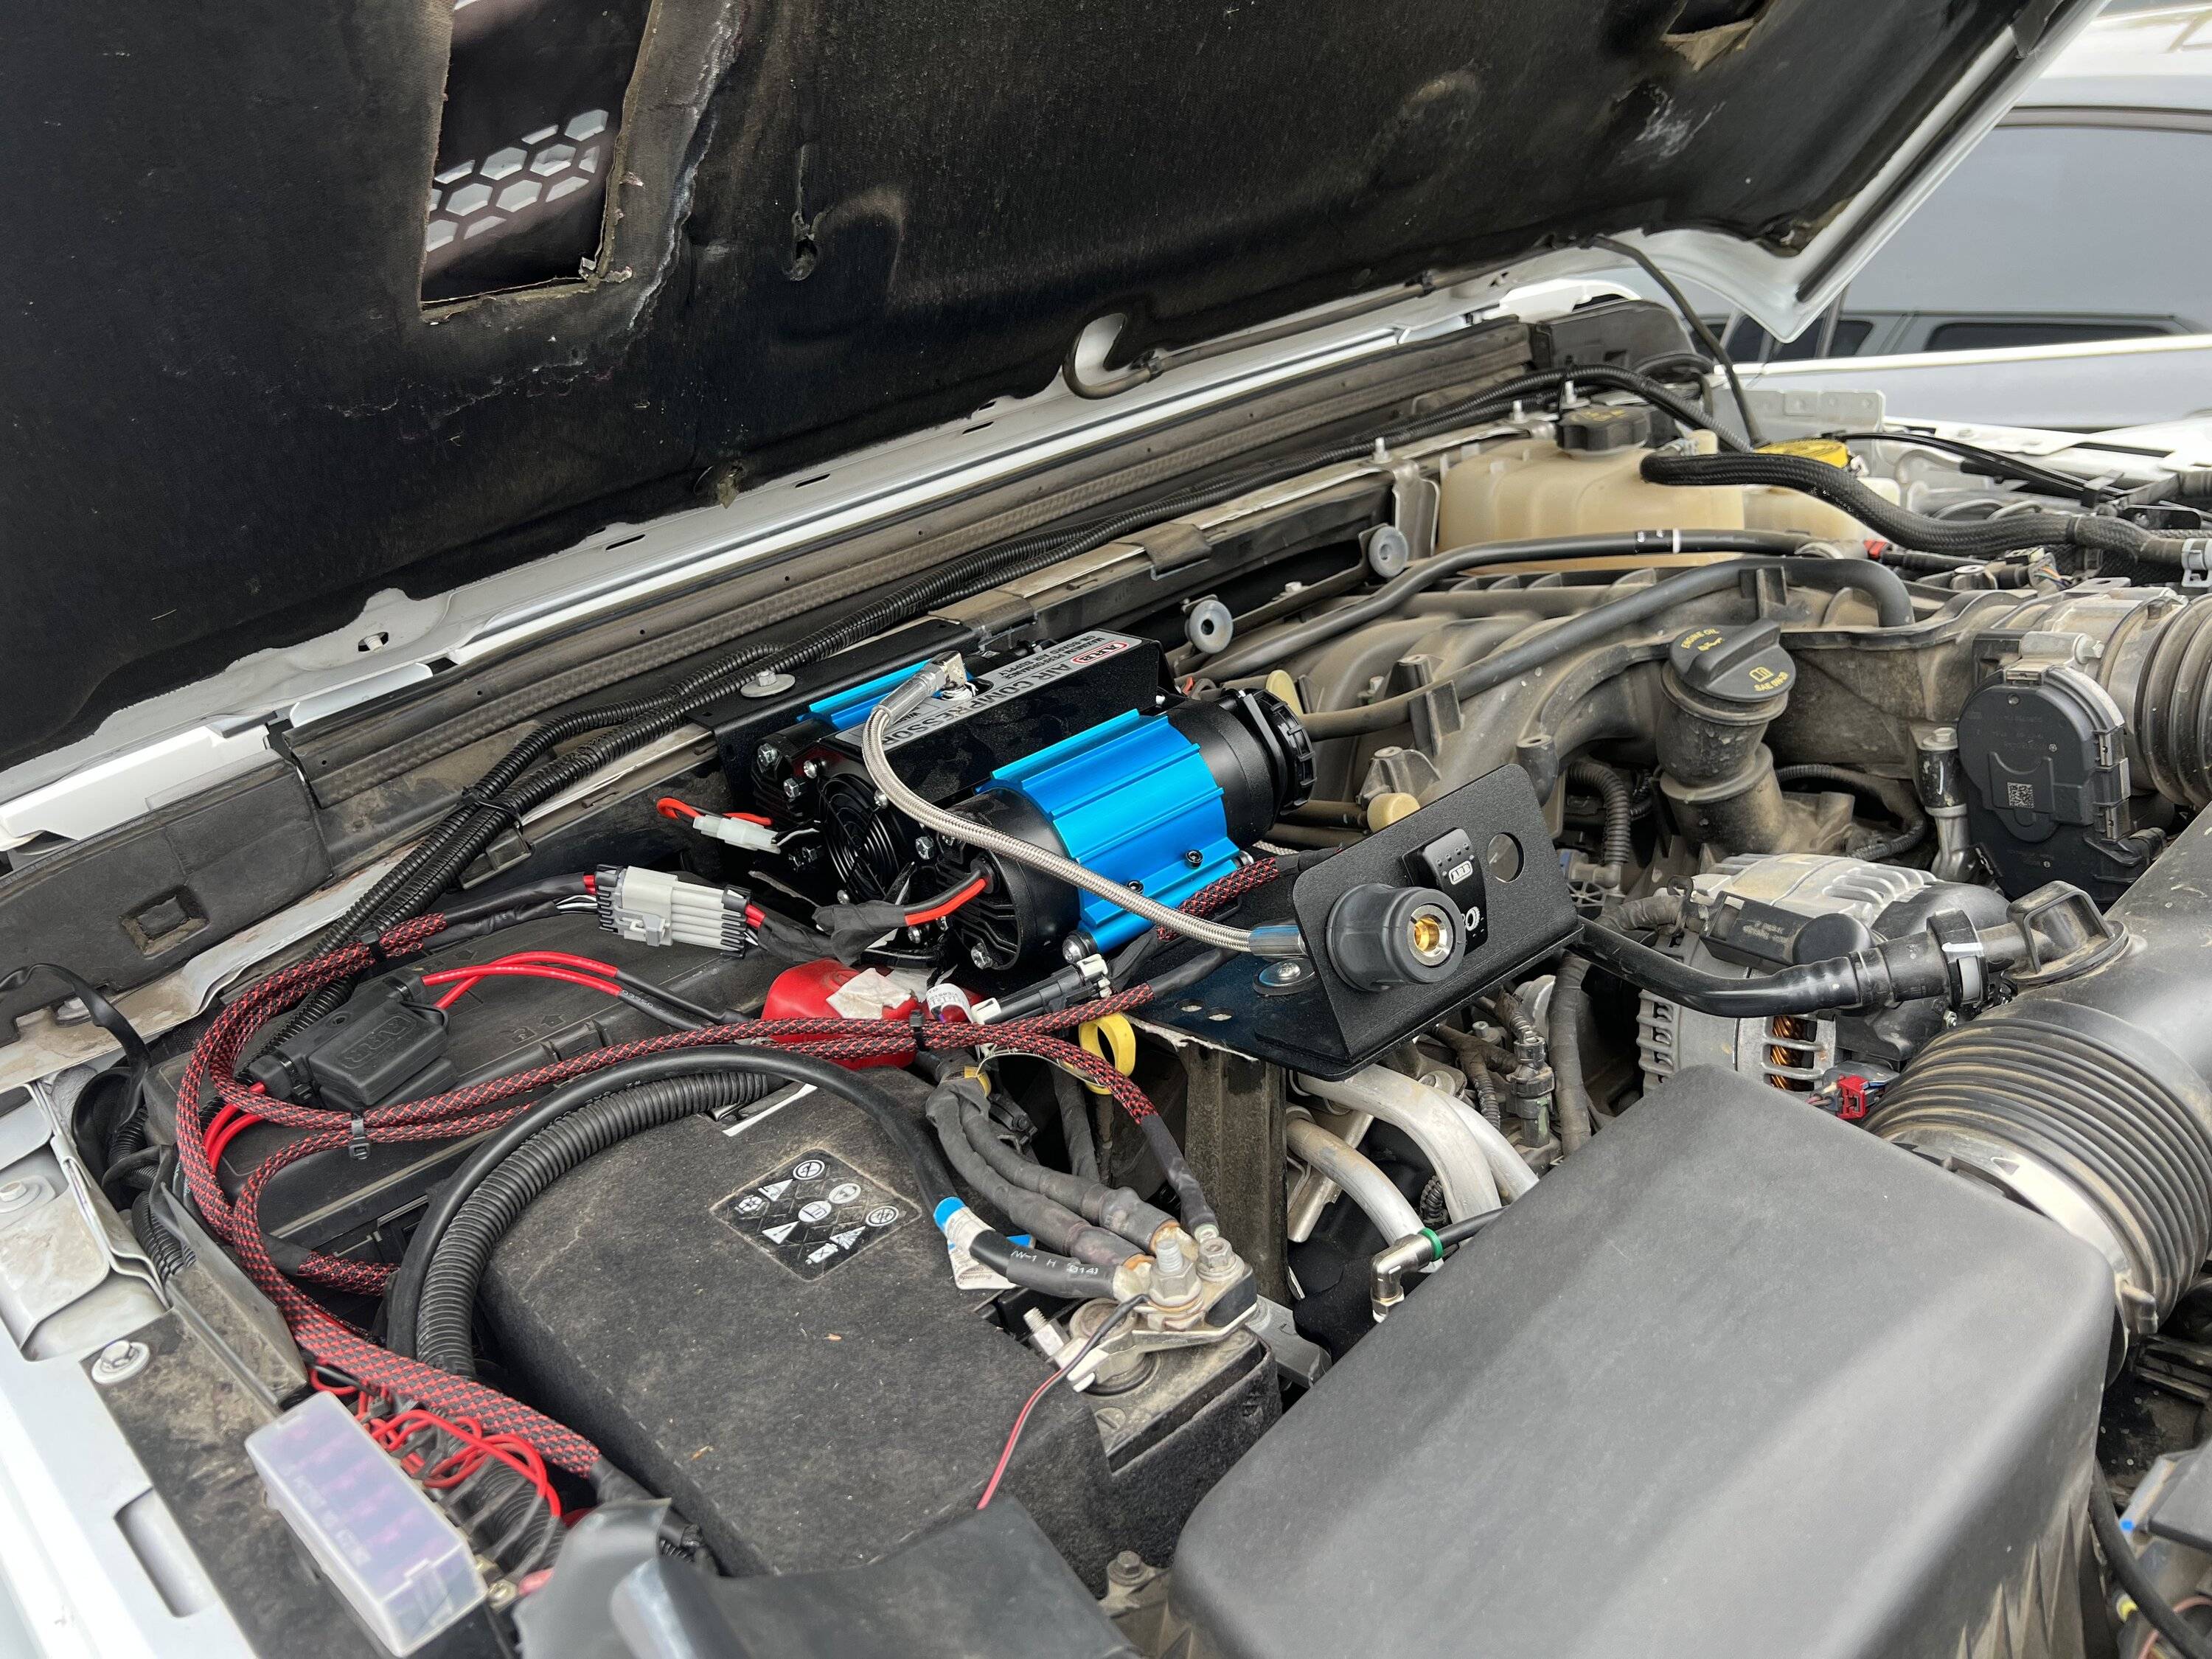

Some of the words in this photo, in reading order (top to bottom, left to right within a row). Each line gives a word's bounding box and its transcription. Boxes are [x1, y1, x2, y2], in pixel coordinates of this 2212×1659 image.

[1050, 635, 1096, 655] ON-BOARD
[1064, 637, 1105, 655] MAXIMUM
[1081, 644, 1120, 661] ARB
[1033, 653, 1050, 661] AIR
[998, 660, 1033, 676] SUPPLY
[1002, 653, 1065, 680] PERFORMANCE
[1032, 664, 1072, 681] AIR
[882, 681, 1034, 746] COMPRESSOR
[1451, 862, 1471, 883] ARB
